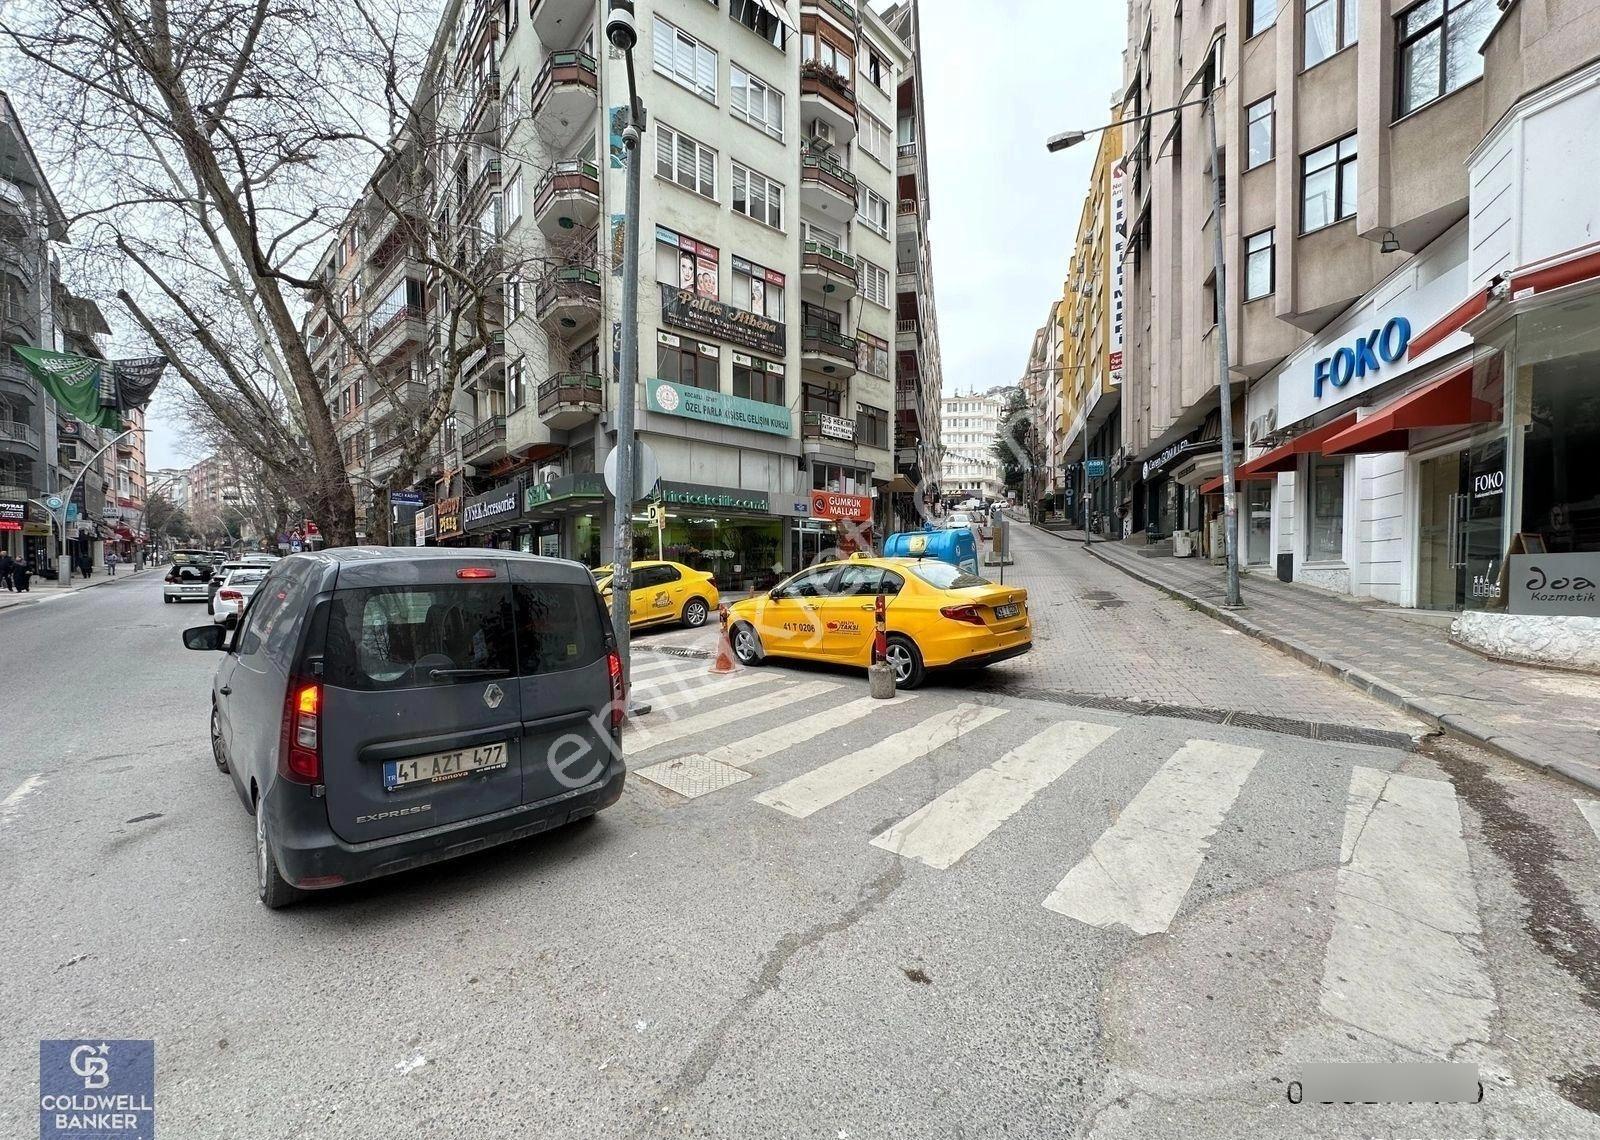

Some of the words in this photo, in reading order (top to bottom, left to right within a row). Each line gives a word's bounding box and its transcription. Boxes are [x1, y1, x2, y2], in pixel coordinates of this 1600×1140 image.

[677, 291, 721, 315] Pallas
[728, 311, 777, 333] Athena
[1313, 316, 1412, 398] FOKO
[685, 400, 702, 414] ÖZEL
[703, 404, 722, 417] PARLA
[771, 418, 789, 430] KURSU
[1474, 470, 1504, 492] FOKO
[829, 495, 861, 507] GÜMRÜK
[830, 506, 861, 517] MALLARI
[1531, 592, 1596, 602] Kozmetik
[783, 622, 791, 631] 41
[799, 623, 816, 633] 0206
[398, 761, 418, 781] 41
[432, 752, 463, 775] AZT
[473, 745, 503, 765] 477
[431, 771, 469, 783] Otonova
[356, 803, 432, 824] EXPRESS
